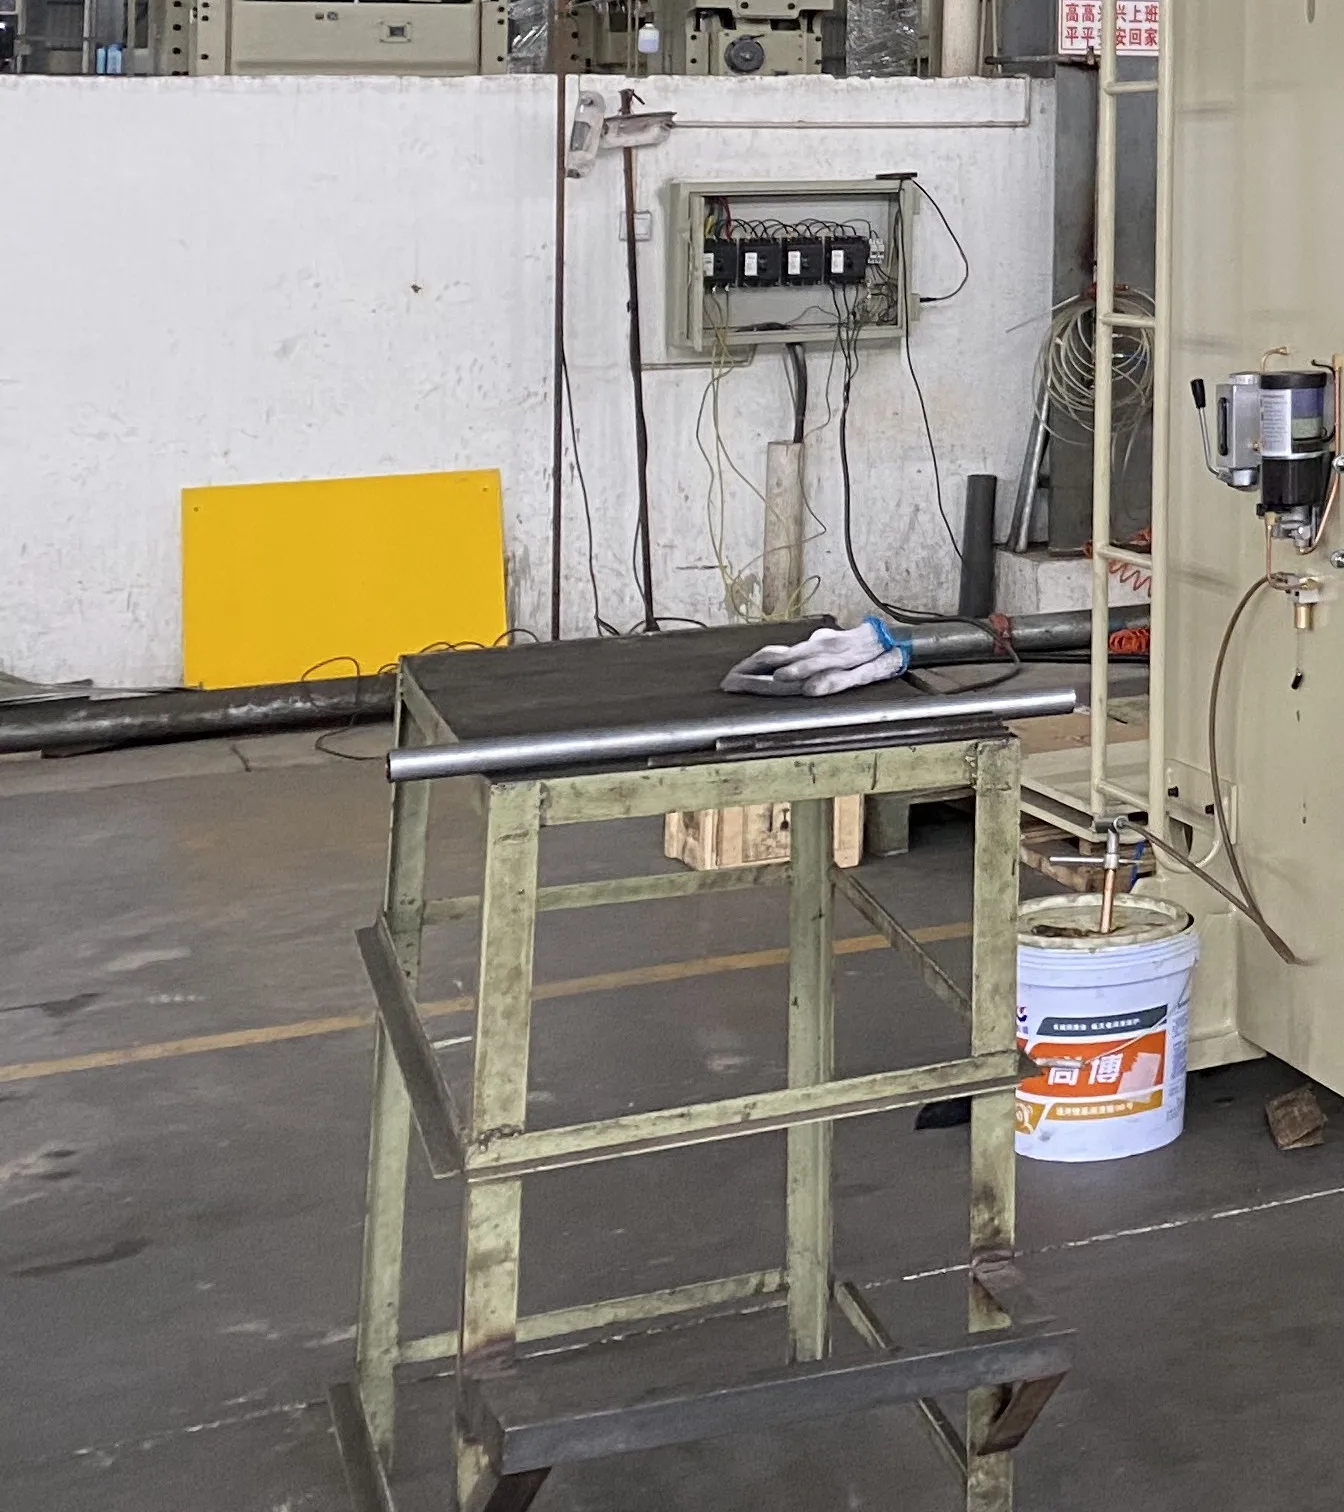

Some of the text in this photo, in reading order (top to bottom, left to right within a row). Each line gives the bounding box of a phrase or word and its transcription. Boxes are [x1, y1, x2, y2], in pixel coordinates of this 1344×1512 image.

[1065, 3, 1159, 24] 高高兴上班
[1064, 26, 1159, 47] 平平安回家
